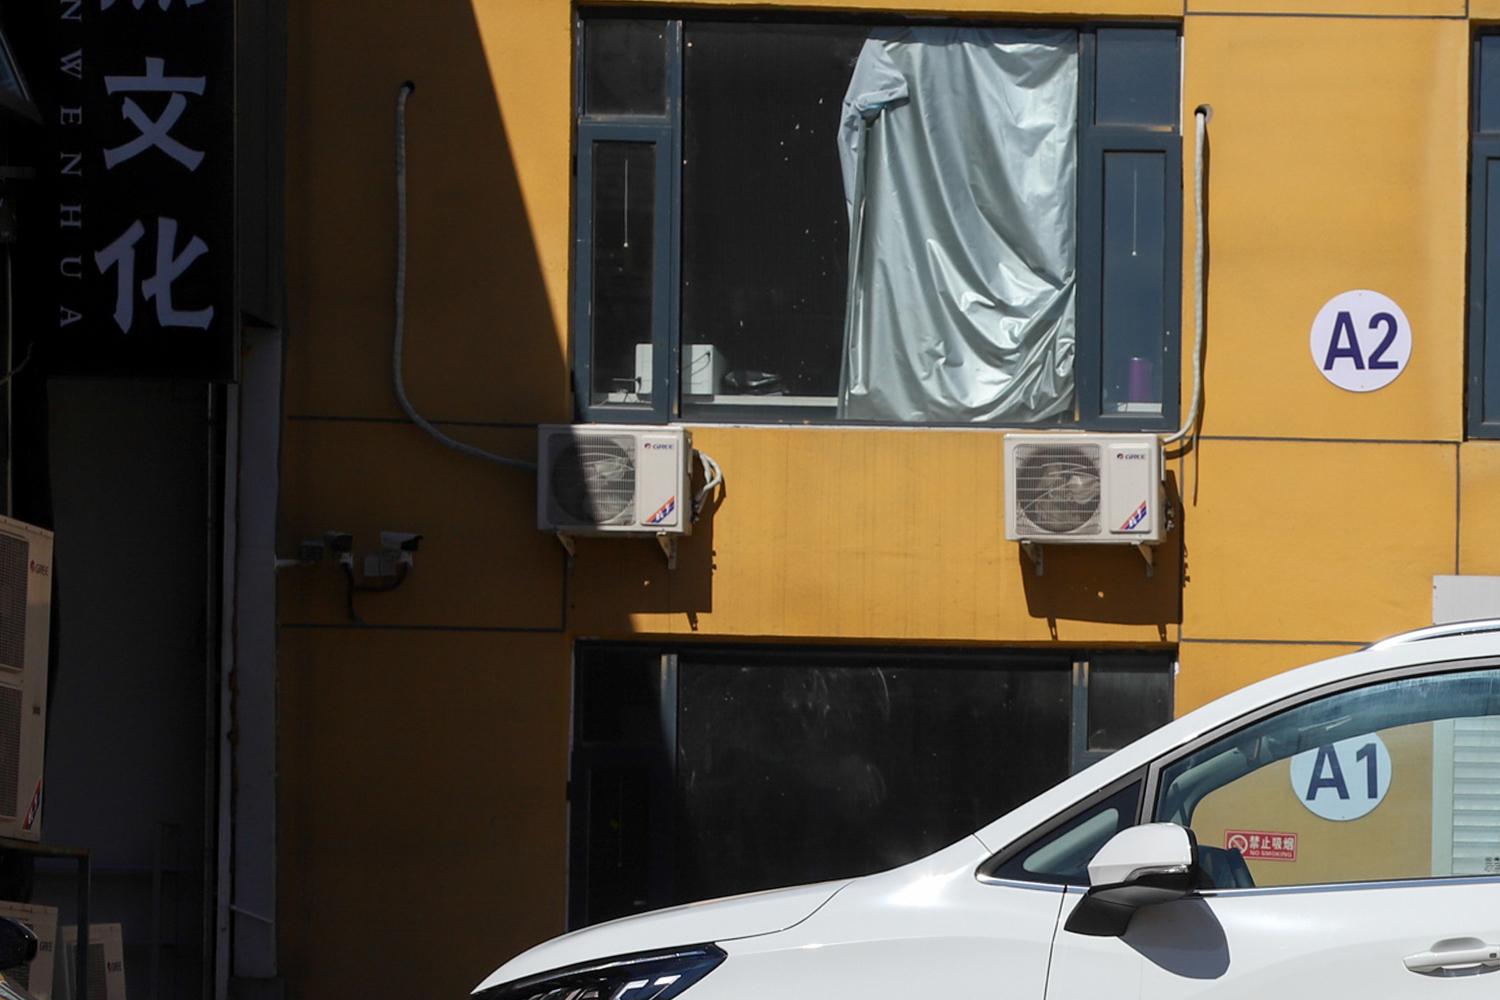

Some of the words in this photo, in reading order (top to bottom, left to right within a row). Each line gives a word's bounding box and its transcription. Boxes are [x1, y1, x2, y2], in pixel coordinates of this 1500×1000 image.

[94, 0, 214, 334] 文化
[1323, 311, 1399, 370] A2
[1306, 743, 1378, 800] A1
[1249, 835, 1295, 850] 禁止吸烟
[1261, 850, 1293, 858] SMOKING
